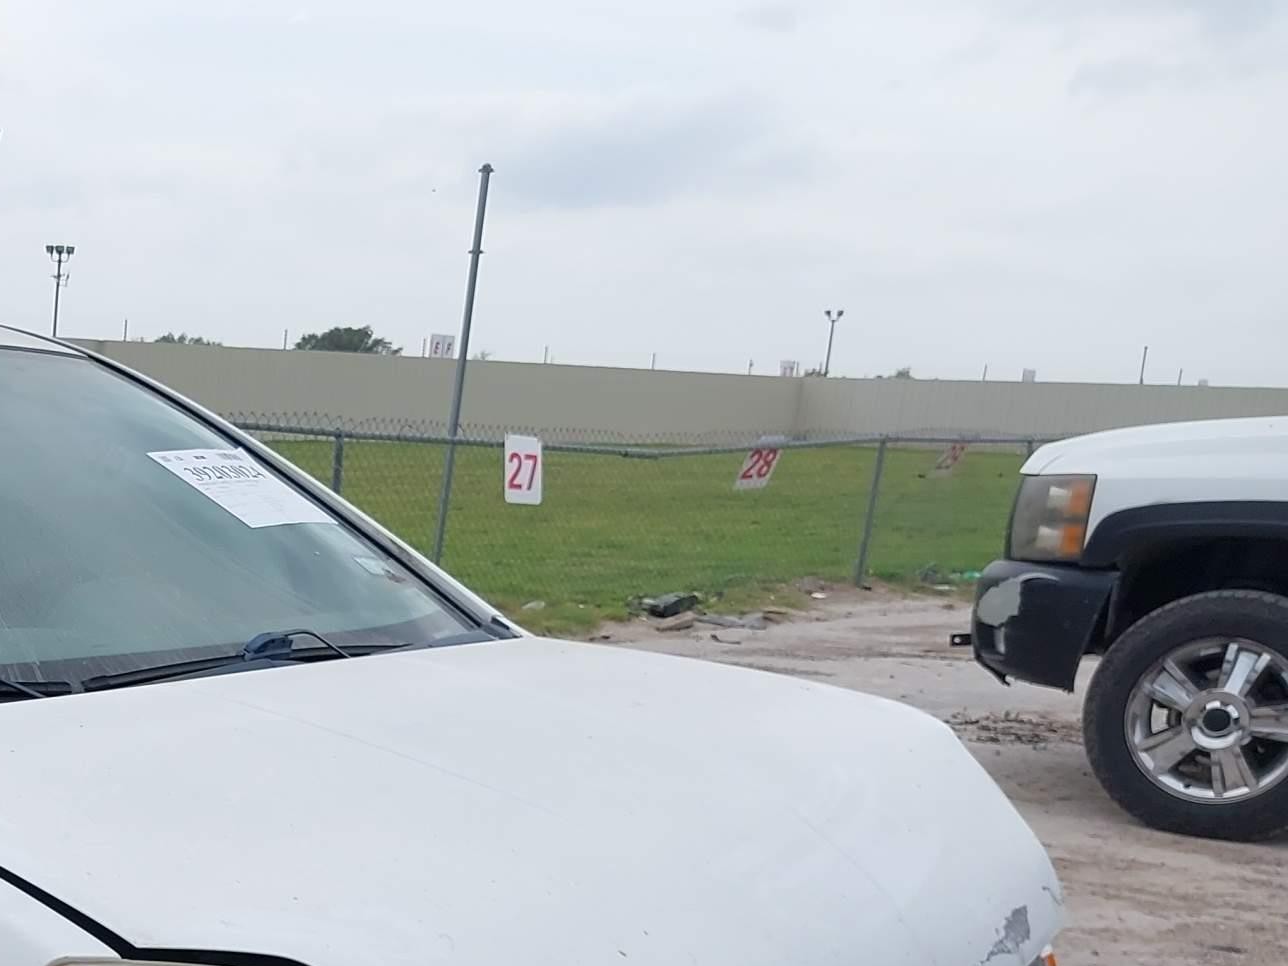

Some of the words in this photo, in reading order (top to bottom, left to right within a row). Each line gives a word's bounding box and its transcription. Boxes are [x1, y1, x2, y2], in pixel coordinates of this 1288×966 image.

[183, 465, 267, 482] 39203024
[507, 452, 538, 491] 27
[740, 448, 778, 479] 28
